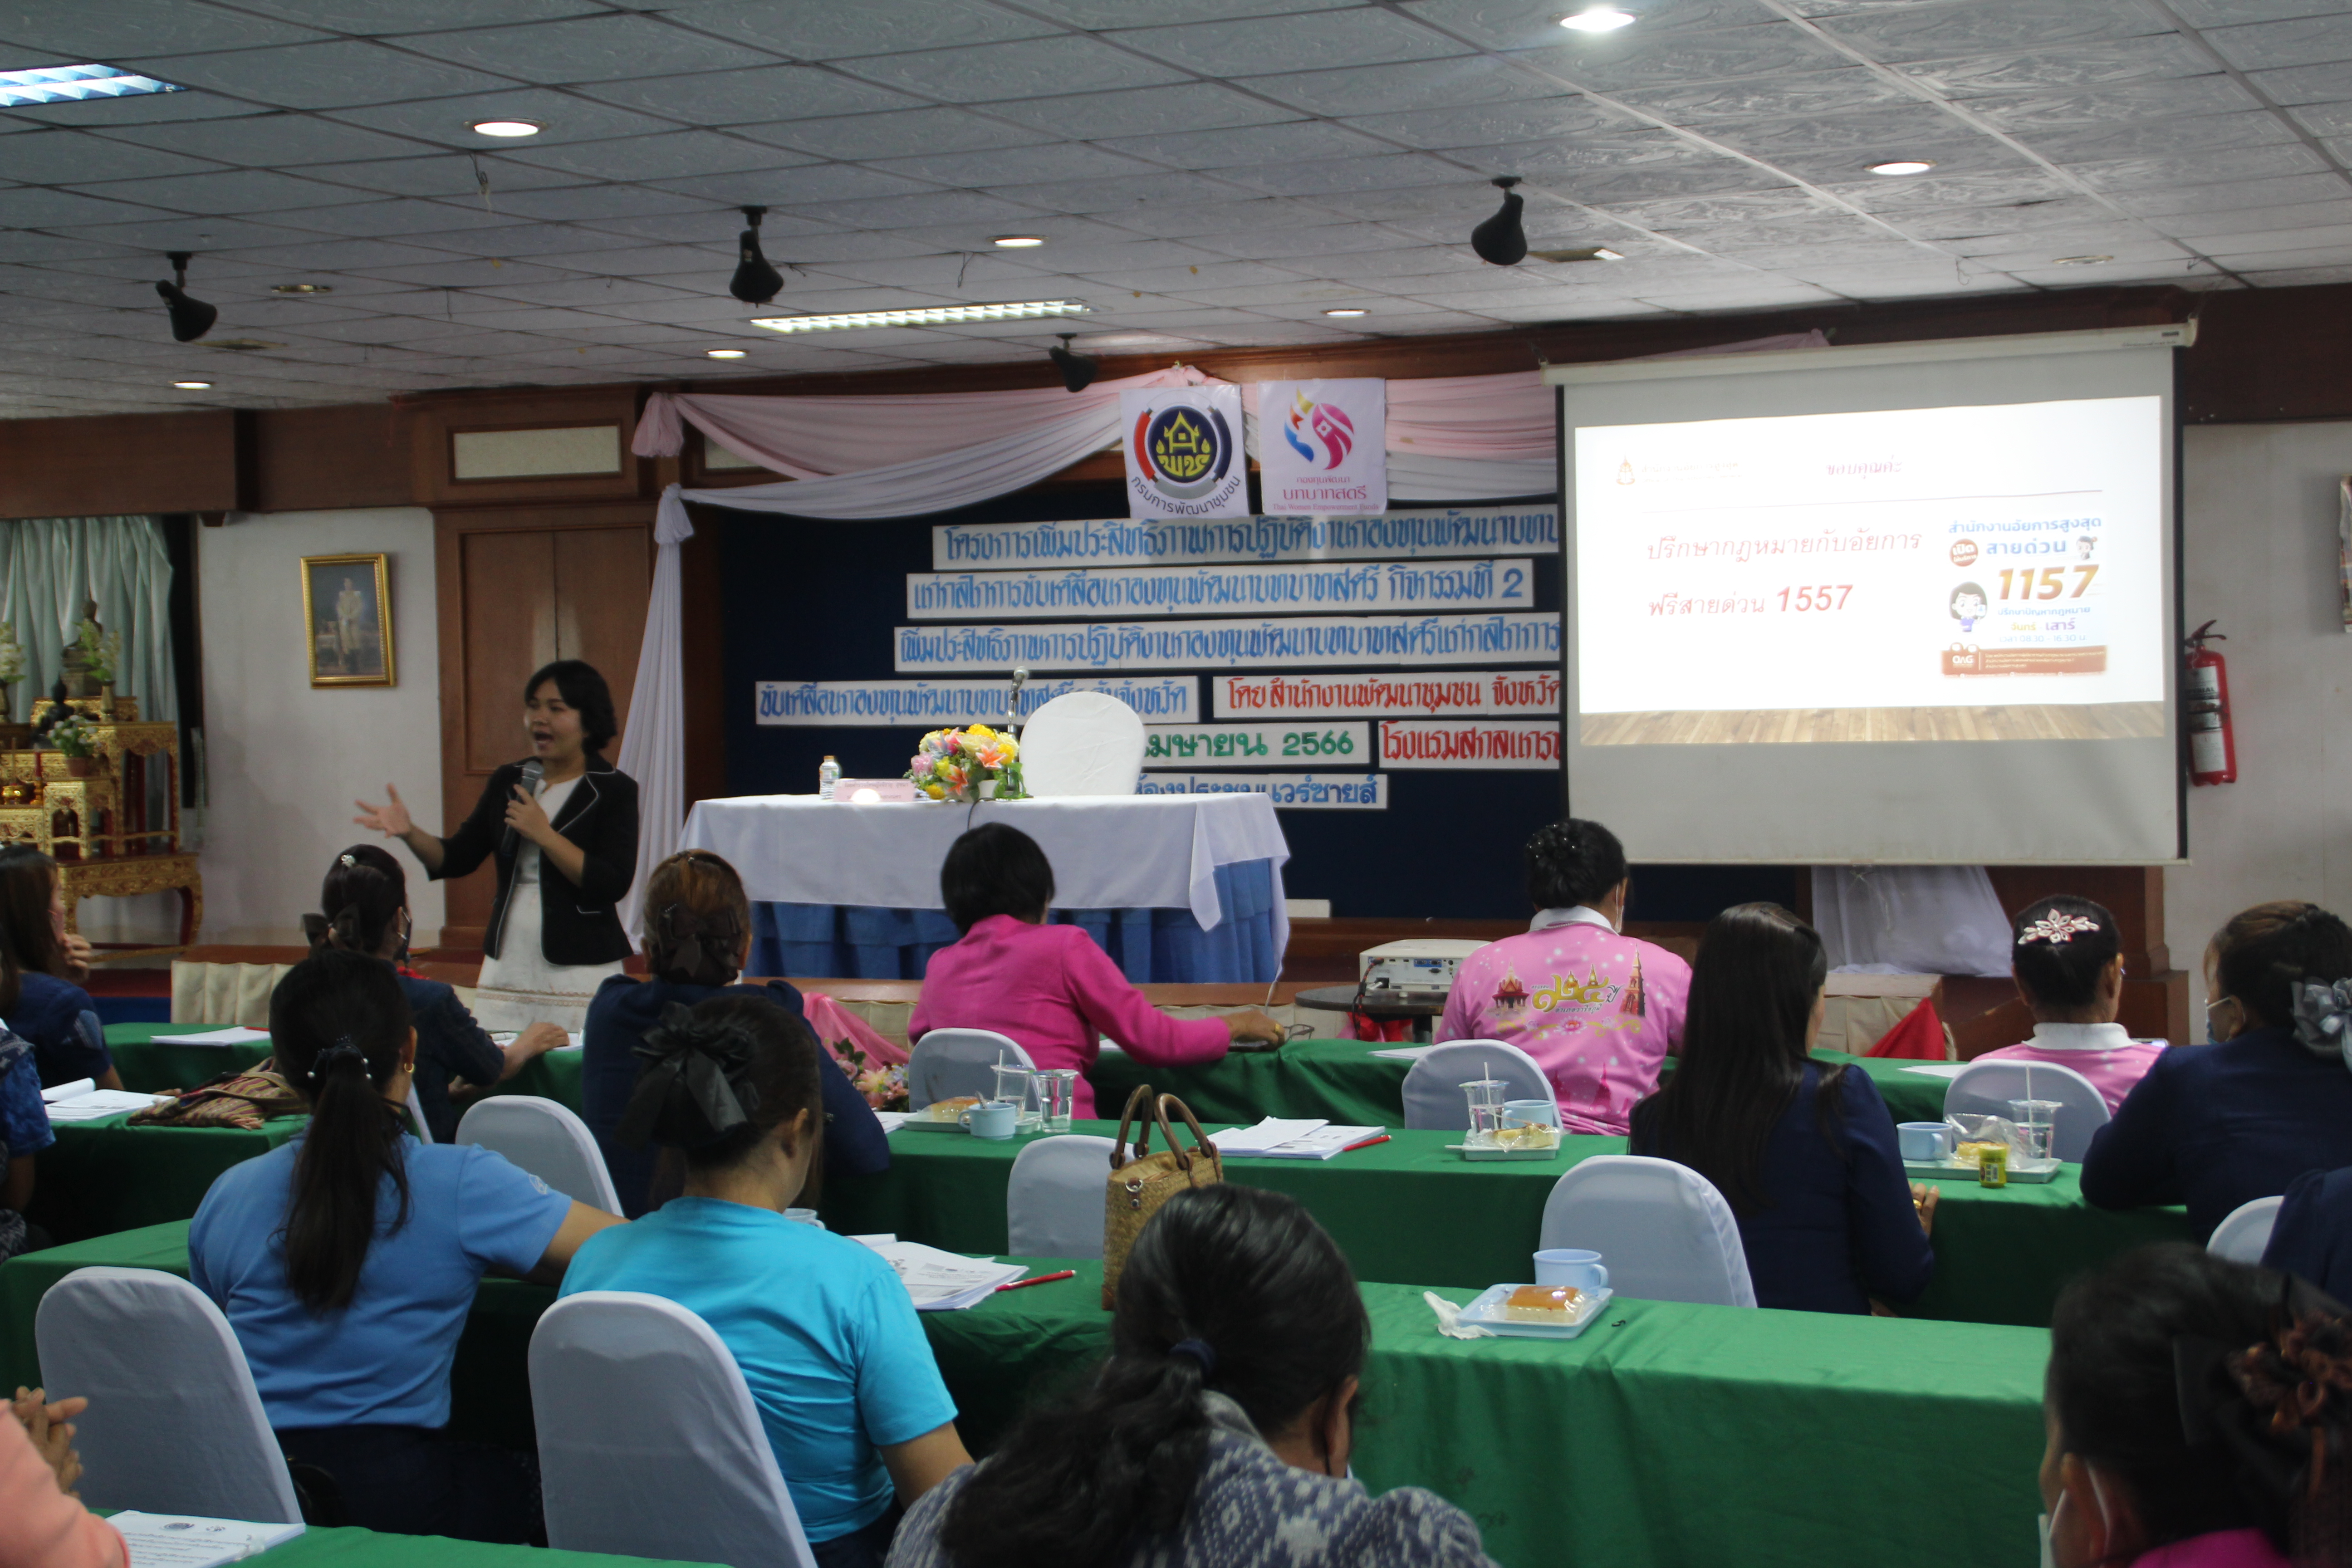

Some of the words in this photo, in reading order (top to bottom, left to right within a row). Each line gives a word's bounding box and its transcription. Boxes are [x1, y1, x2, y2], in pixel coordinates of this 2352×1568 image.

[1825, 454, 1902, 480] ขอบคุณค่ะ
[1297, 476, 1350, 485] กองทุนพัฒนา
[1131, 475, 1241, 515] กรมการพัฒนาชุมชน
[1283, 485, 1367, 500] บทบาทสตรี
[1948, 517, 2102, 534] สำนักงานอัยการสูงสุด
[1952, 543, 1975, 555] เปิด
[1986, 537, 2066, 555] สายด่วน
[1387, 561, 1494, 602] กิจกรรมที่
[1501, 568, 1523, 598] 2
[1997, 564, 2100, 600] 1157
[1648, 591, 1764, 616] ฟรีสายด่วน
[1777, 584, 1853, 612] 1557
[2011, 621, 2037, 631] จันทร์
[2045, 617, 2076, 631] เสาร์
[1144, 732, 1269, 758] มษายน
[1282, 730, 1354, 756] 2566
